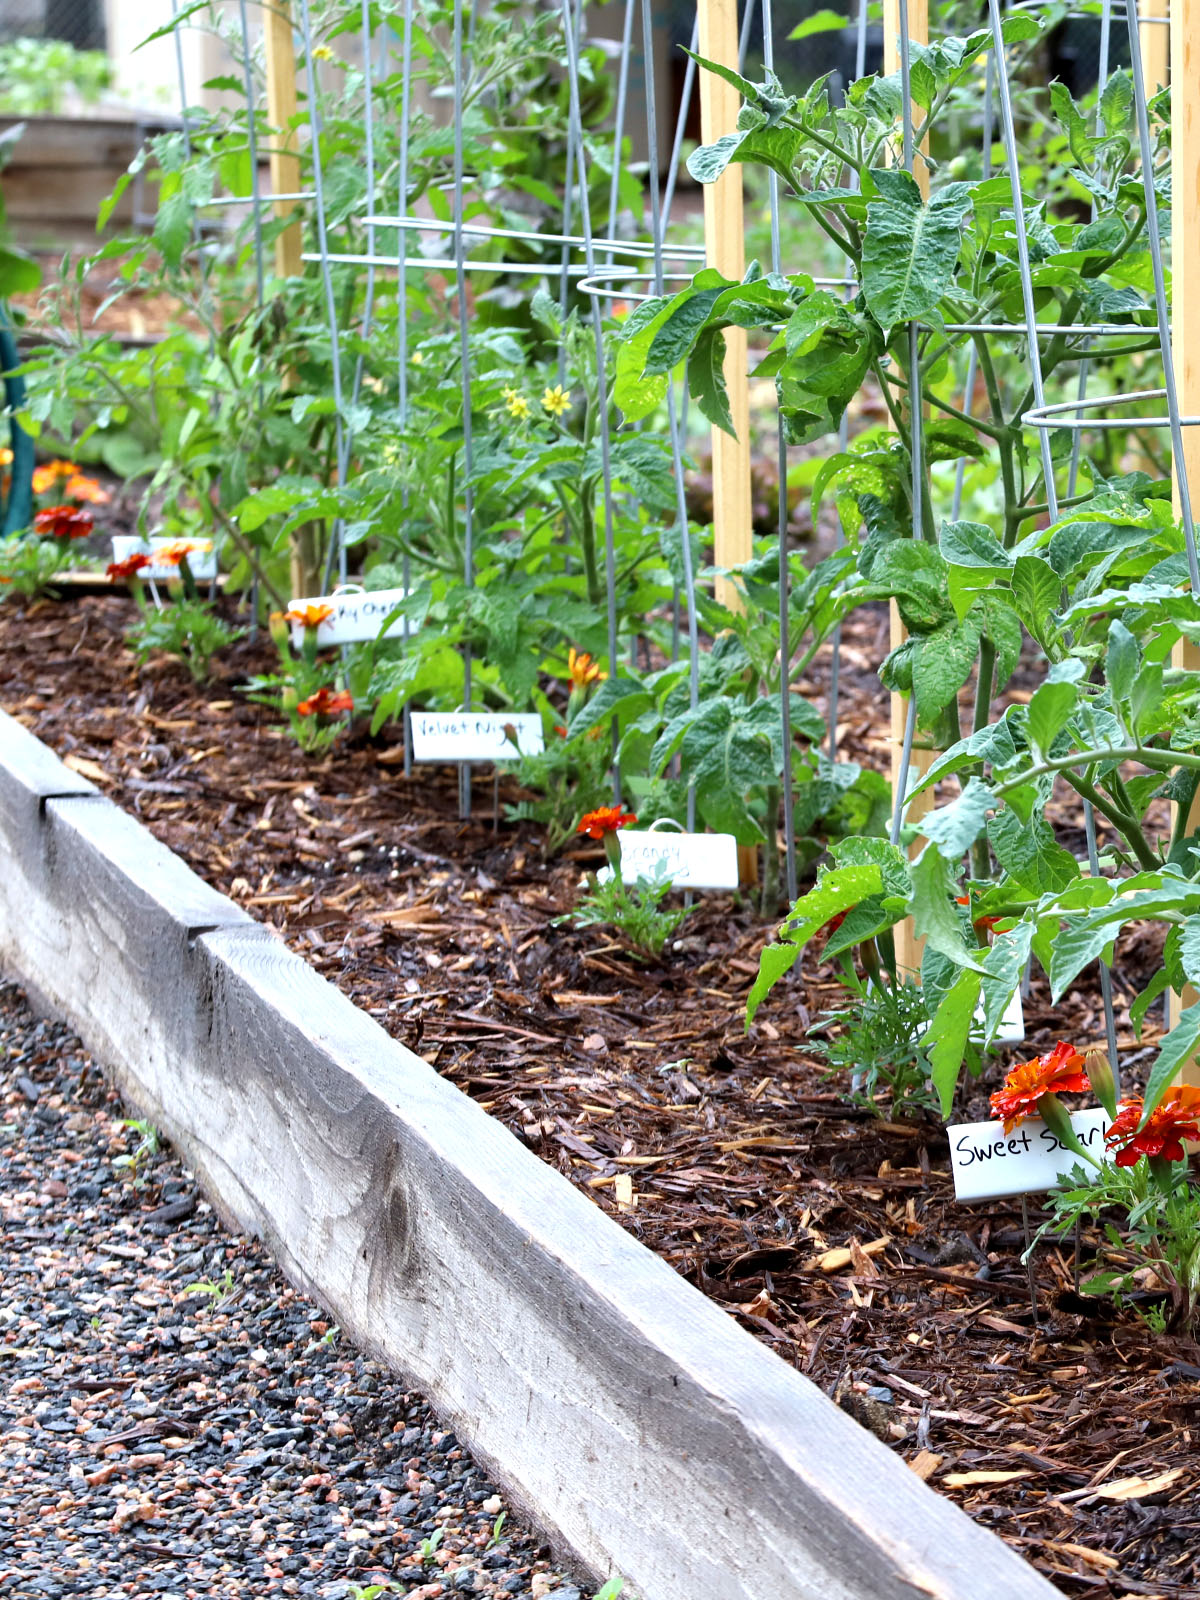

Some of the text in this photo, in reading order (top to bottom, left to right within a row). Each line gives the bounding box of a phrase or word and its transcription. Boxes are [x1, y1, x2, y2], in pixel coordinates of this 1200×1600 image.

[419, 719, 526, 745] Velvet Nigt
[956, 1130, 1032, 1166] Sweet
